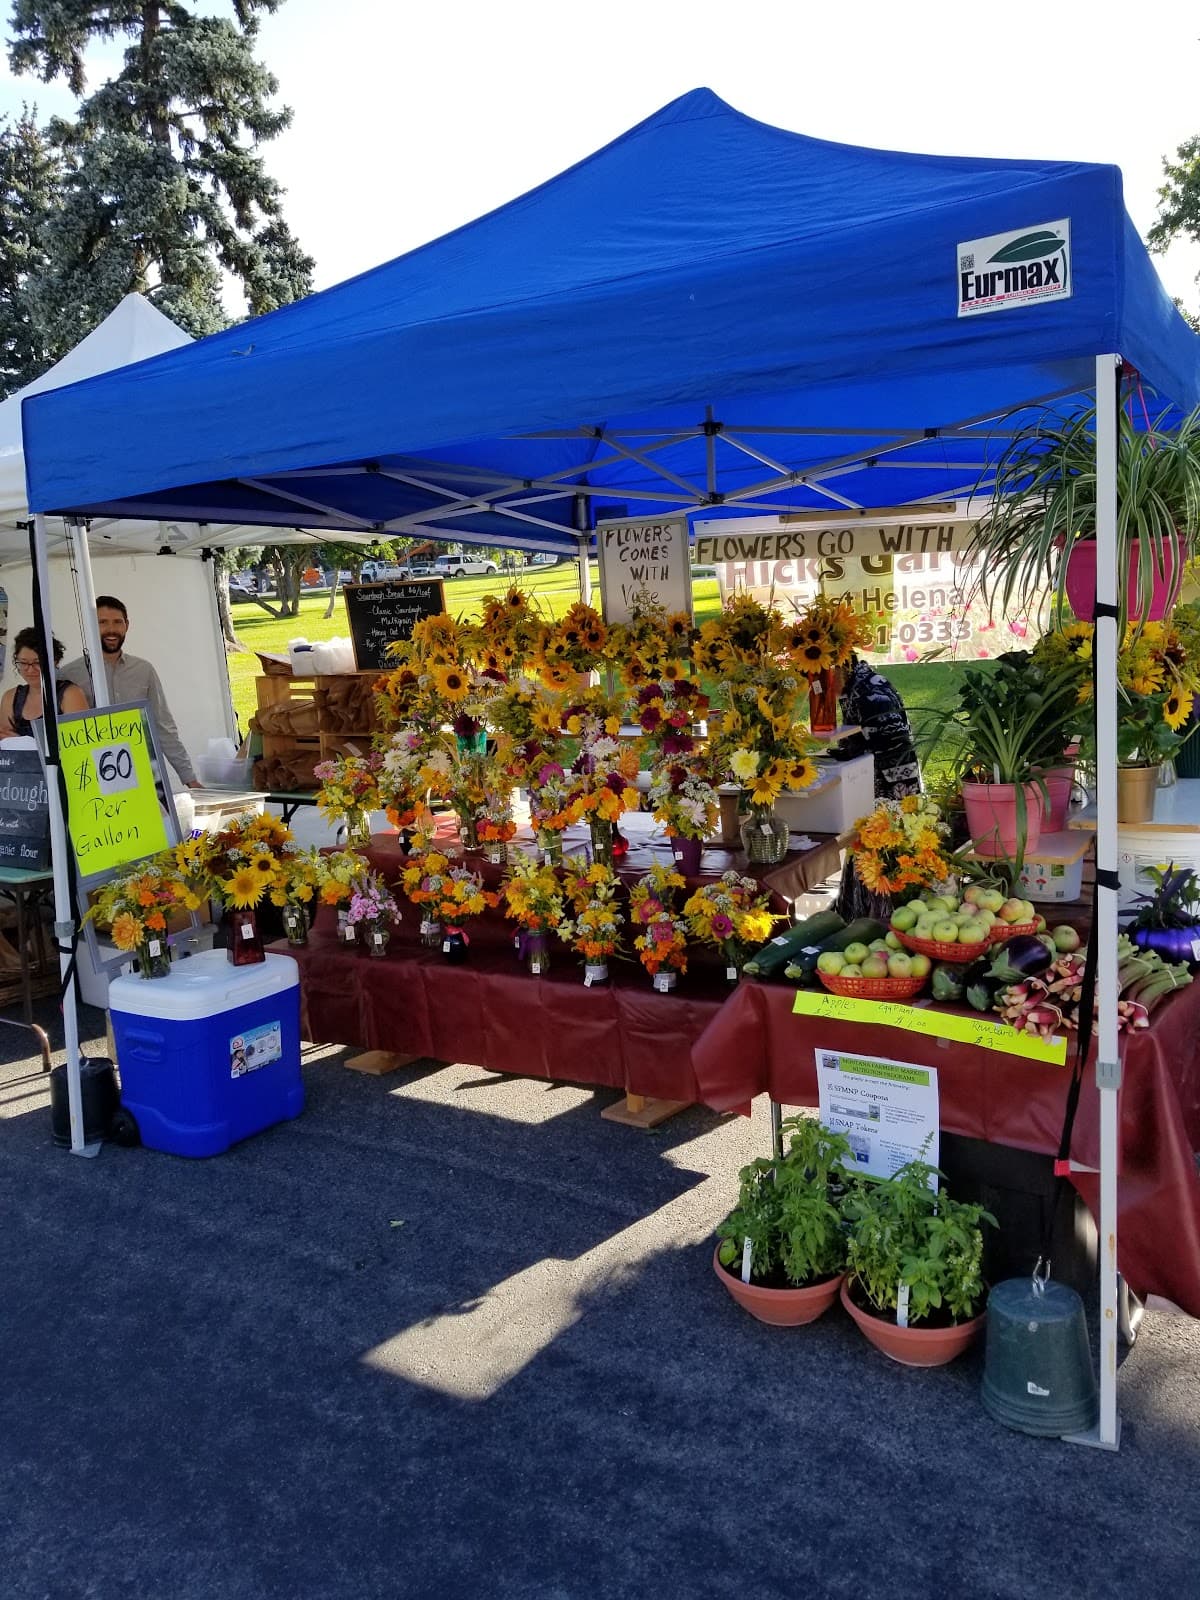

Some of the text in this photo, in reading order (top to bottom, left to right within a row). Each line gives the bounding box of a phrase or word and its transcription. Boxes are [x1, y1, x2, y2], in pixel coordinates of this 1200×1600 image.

[961, 257, 1060, 302] Eurmax
[606, 525, 672, 547] FLOWERS
[697, 534, 806, 563] FLOWERS
[817, 530, 854, 556] GO
[879, 526, 954, 552] WITH
[620, 546, 669, 562] COMES
[630, 565, 668, 580] WITH
[863, 586, 965, 612] Helena
[99, 748, 132, 781] 60
[87, 797, 127, 820] Per
[76, 826, 139, 857] Gallon
[860, 1090, 889, 1101] Coupons
